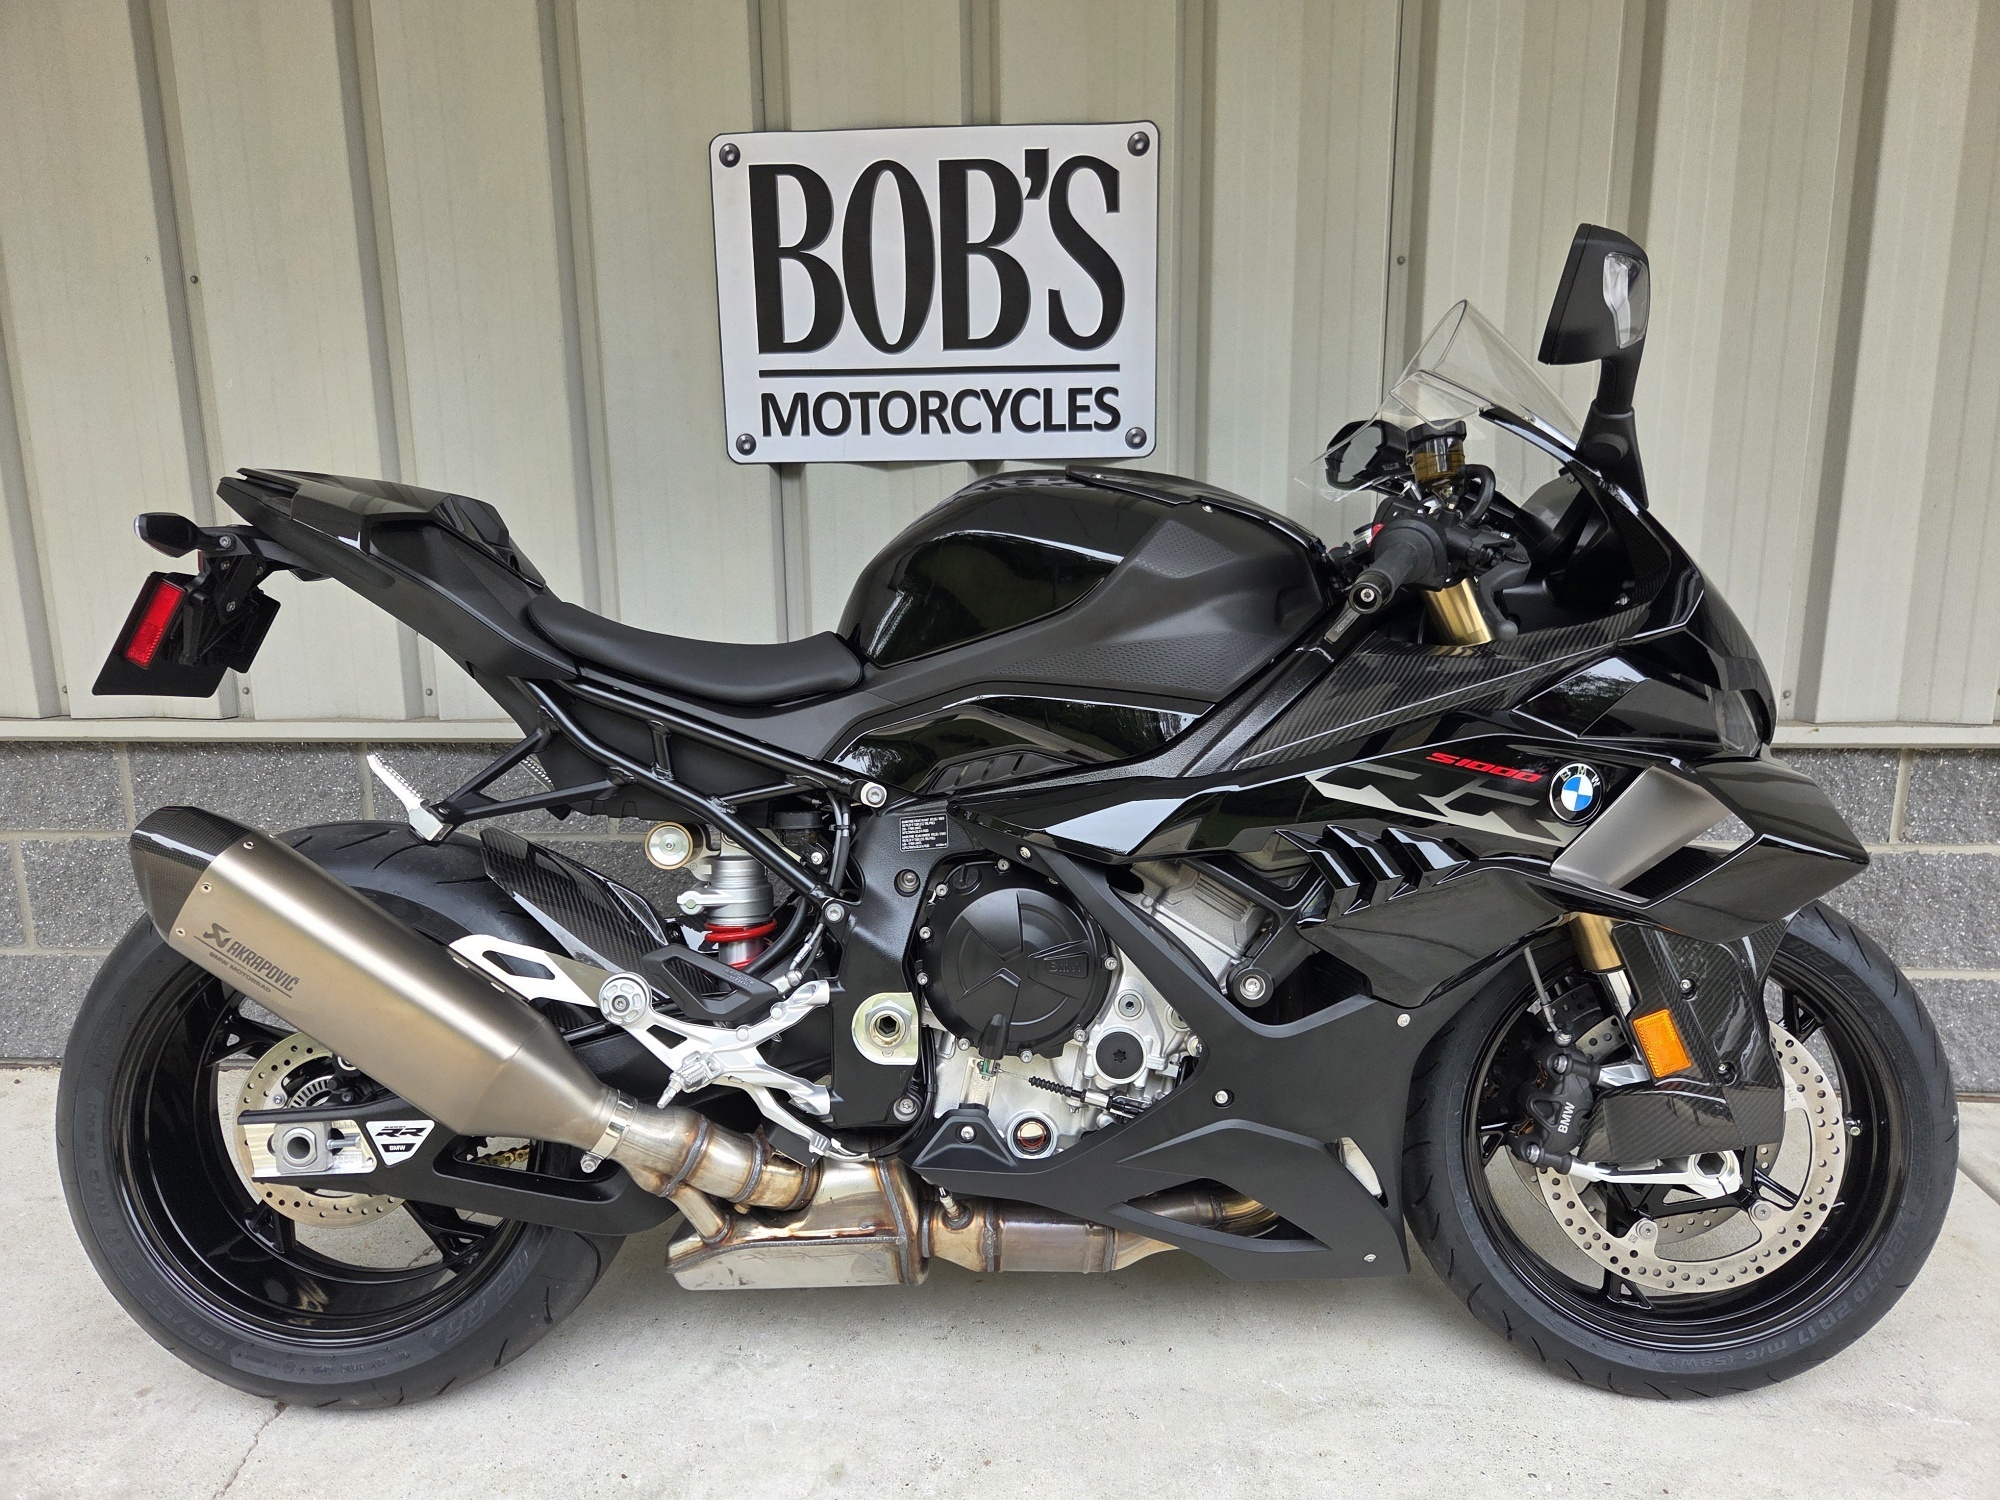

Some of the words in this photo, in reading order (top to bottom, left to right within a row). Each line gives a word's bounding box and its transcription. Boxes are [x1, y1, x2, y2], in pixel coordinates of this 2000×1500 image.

[748, 148, 1126, 354] BOB'S
[761, 386, 1122, 437] MOTORCYCLES
[1425, 752, 1543, 783] S1000
[1560, 765, 1600, 788] BMW
[209, 951, 229, 967] BMW
[230, 964, 272, 993] MOTORRAD
[227, 940, 301, 993] AKRAPOVIČ
[1557, 1101, 1576, 1134] BMW
